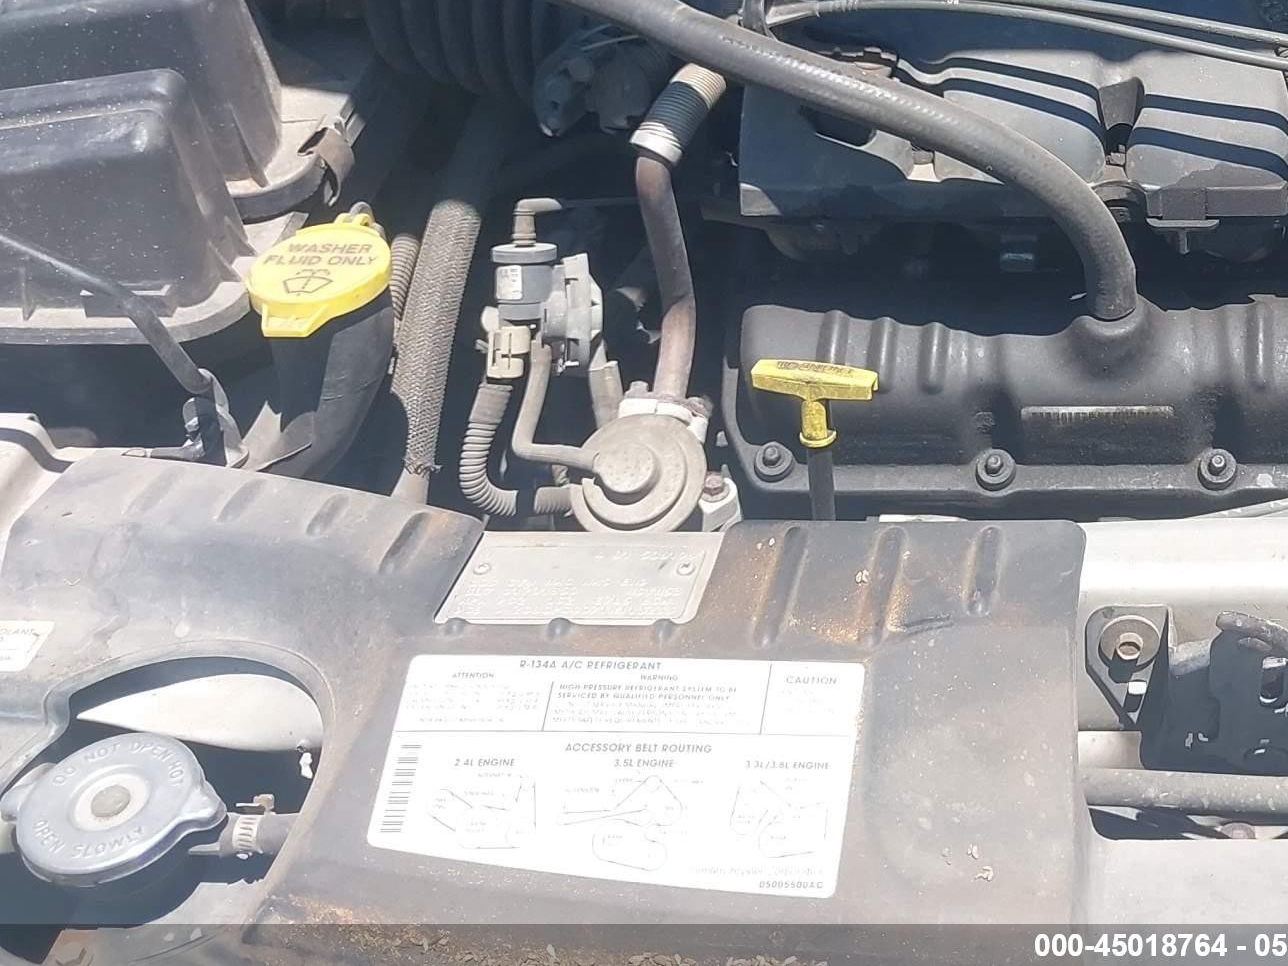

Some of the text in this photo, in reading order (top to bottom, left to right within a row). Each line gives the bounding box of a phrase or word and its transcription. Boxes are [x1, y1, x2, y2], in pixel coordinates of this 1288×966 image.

[287, 244, 373, 254] WASHER
[263, 255, 379, 266] FLUID ONLY
[519, 660, 662, 670] R-134A A/C REFRIGERANT
[786, 676, 837, 684] CAUTION
[565, 742, 712, 753] ACCESSORY BELT ROUTING
[52, 741, 185, 787] DO NOT OPEN HOT
[478, 758, 515, 767] ENGINE
[614, 759, 674, 767] 3.5L ENGINE
[793, 761, 830, 770] ENGINE
[34, 820, 145, 859] OPEN SLOWLY
